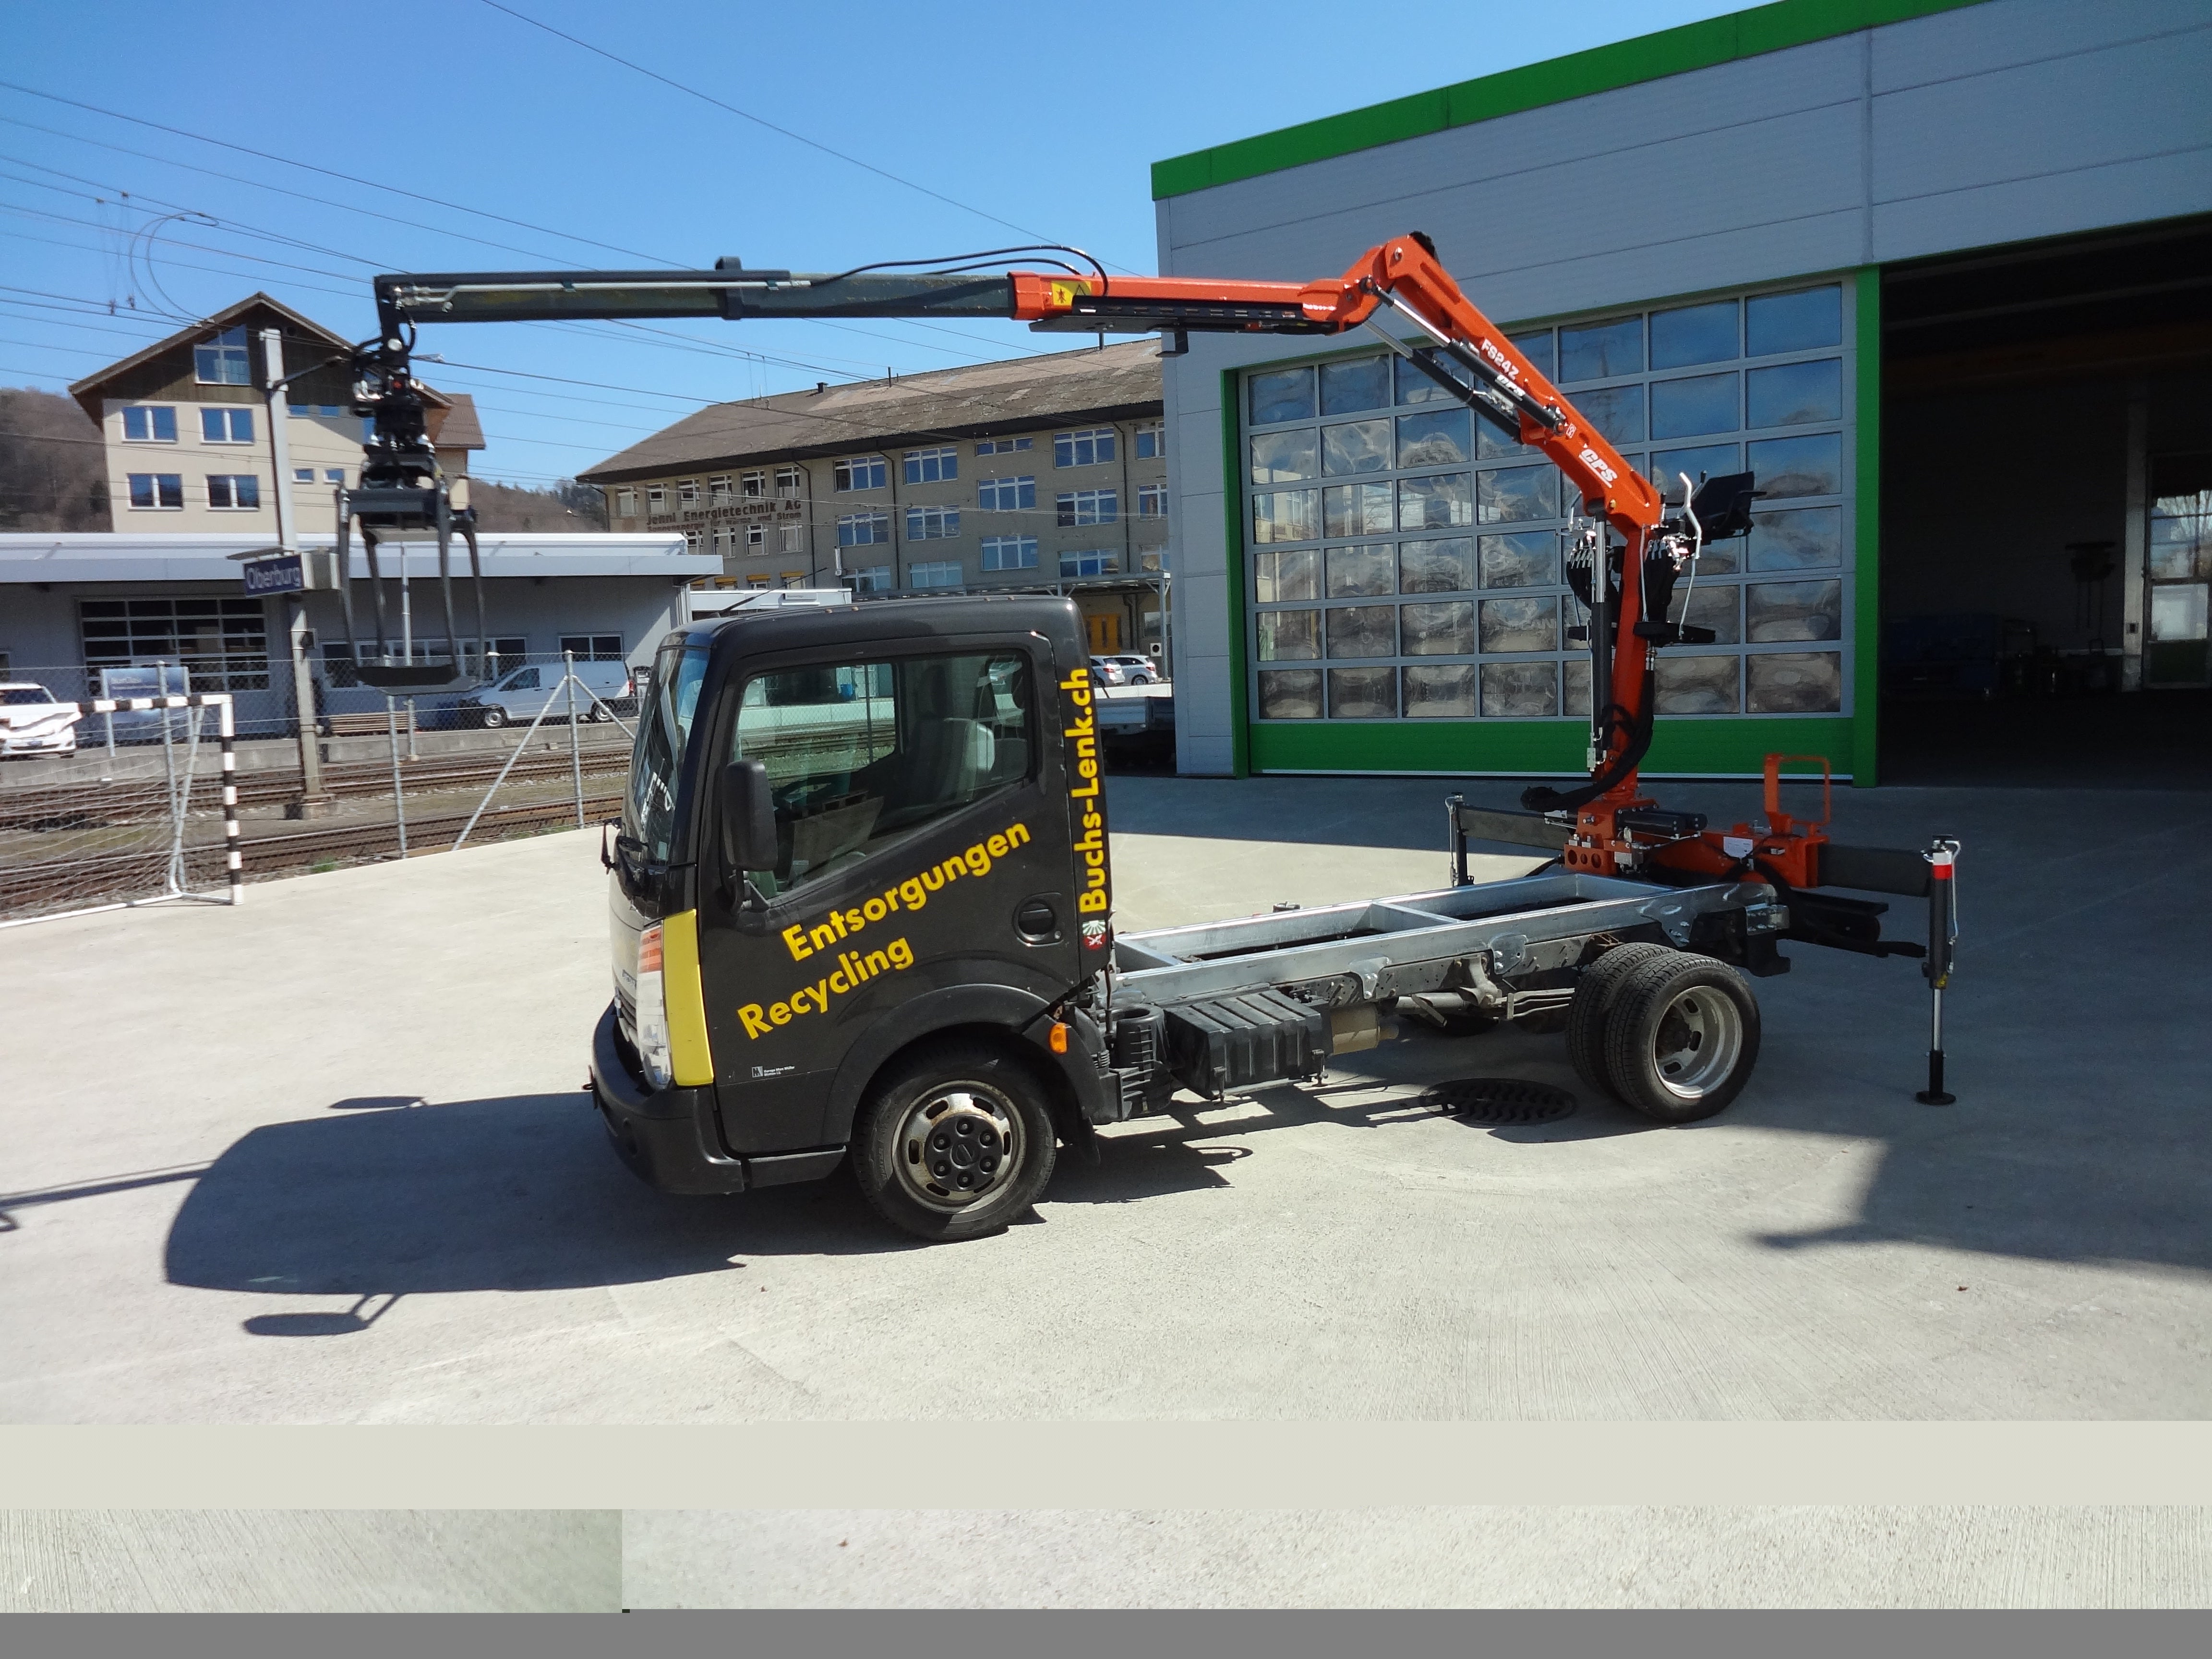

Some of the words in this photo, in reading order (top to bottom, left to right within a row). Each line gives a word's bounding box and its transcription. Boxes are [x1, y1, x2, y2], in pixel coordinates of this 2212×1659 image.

[1580, 448, 1618, 482] CPS
[683, 502, 777, 521] Energietechnik
[784, 500, 801, 511] AG
[777, 512, 802, 520] Strom
[246, 564, 301, 589] Oberburg
[1060, 668, 1107, 913] Buchs-Lenk.ch
[782, 823, 1030, 962] Entsorgungen
[737, 938, 914, 1040] Recycling
